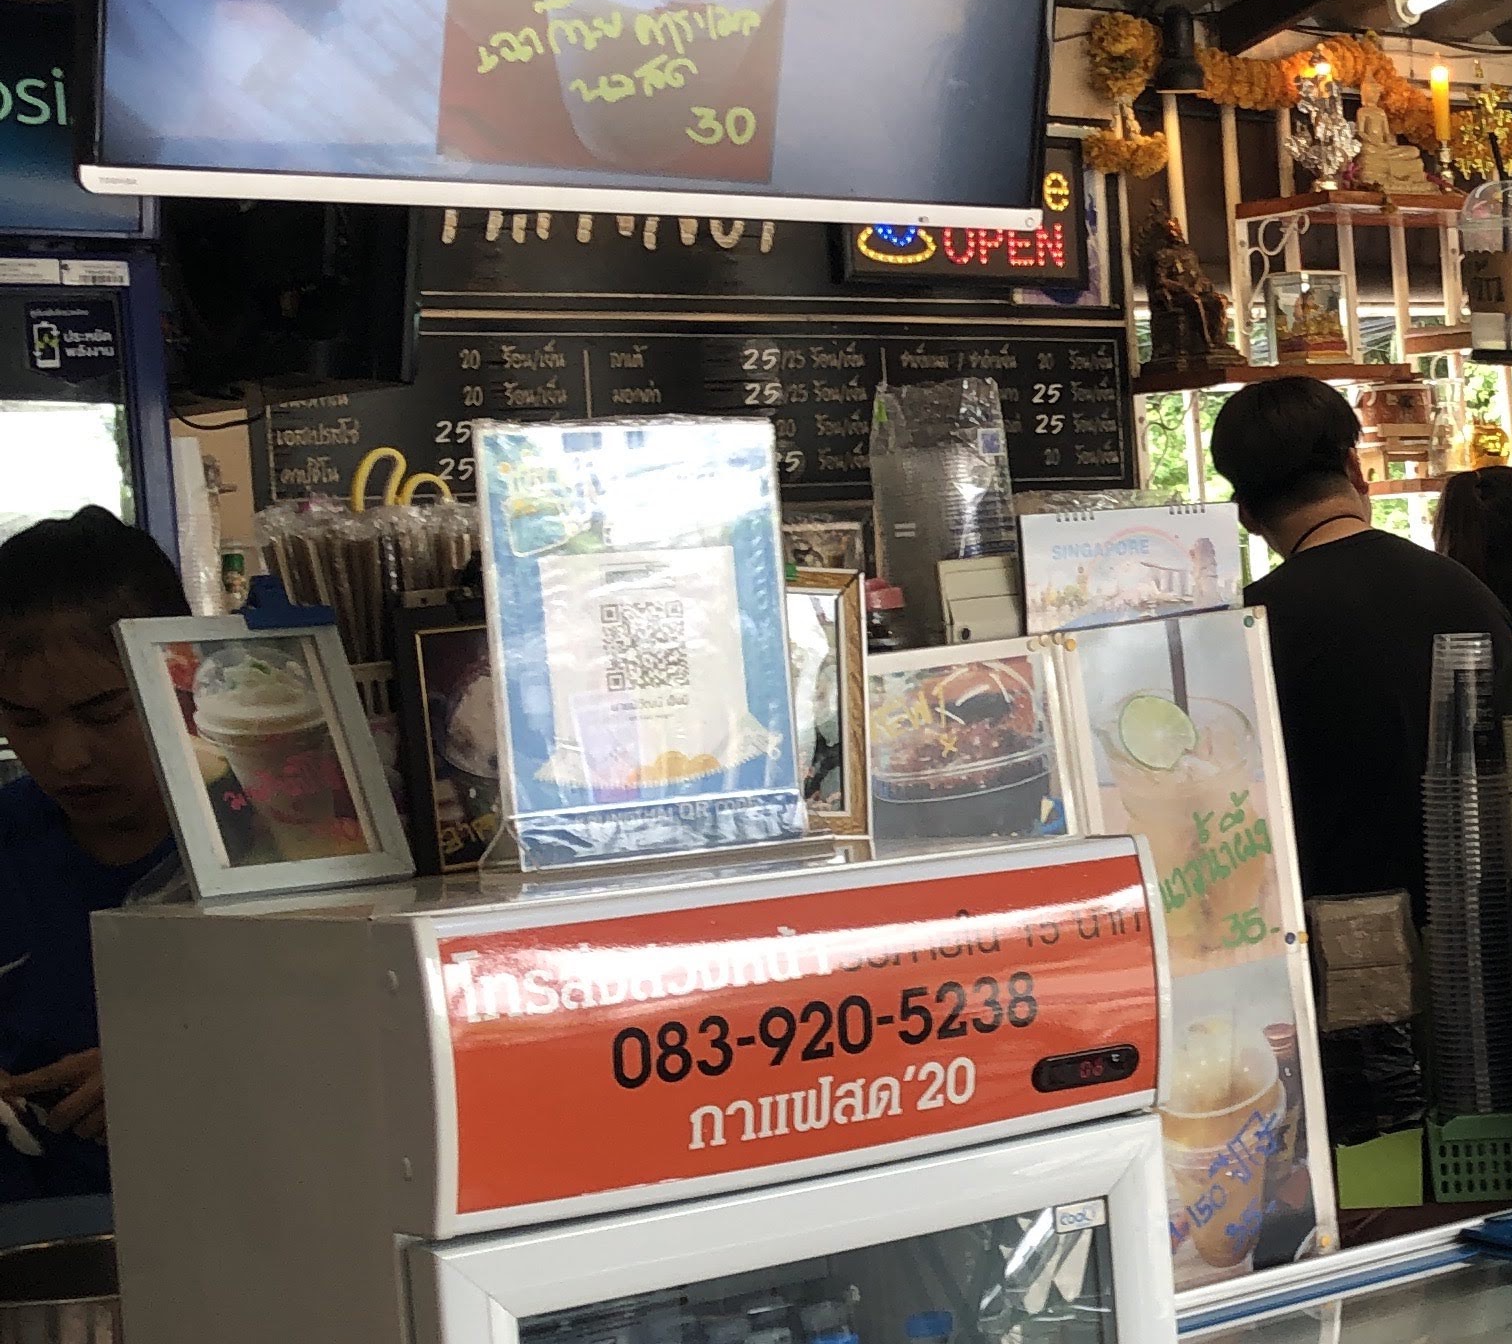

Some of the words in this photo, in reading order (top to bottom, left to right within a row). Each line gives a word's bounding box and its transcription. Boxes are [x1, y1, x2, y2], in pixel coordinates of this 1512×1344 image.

[0, 66, 68, 127] si
[685, 106, 757, 146] 30
[942, 221, 1066, 268] OPEN
[742, 348, 780, 371] 25
[744, 382, 783, 406] 25
[1032, 383, 1064, 404] 25
[1034, 414, 1066, 435] 25
[1051, 538, 1150, 561] SINGAPORE
[611, 971, 1038, 1090] 083-920-5238
